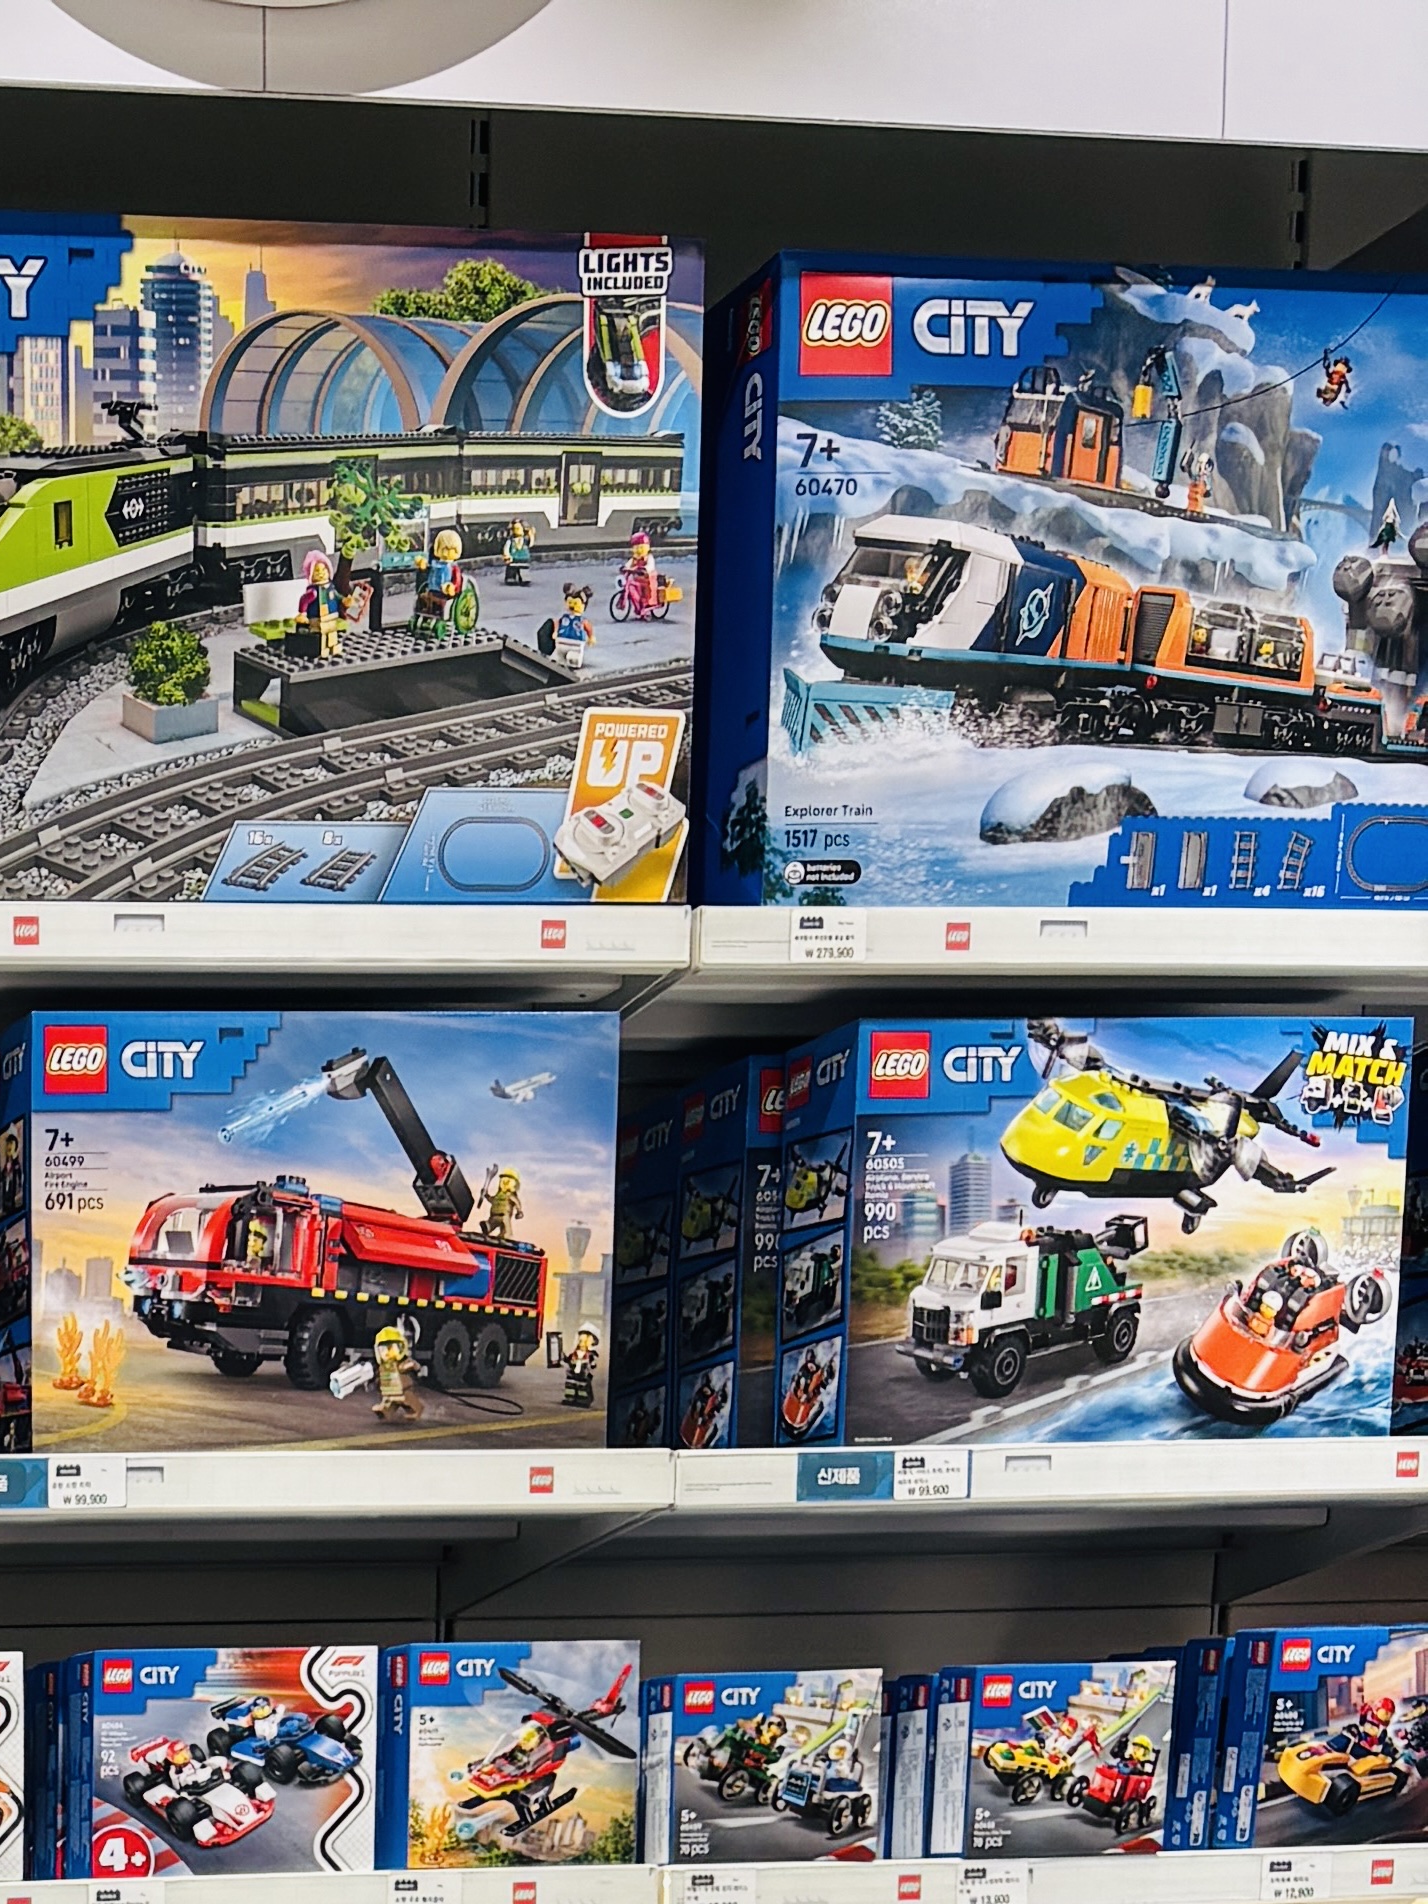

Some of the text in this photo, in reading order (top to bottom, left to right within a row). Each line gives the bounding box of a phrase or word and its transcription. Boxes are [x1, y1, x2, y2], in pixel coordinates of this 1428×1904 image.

[584, 252, 668, 273] LIGHTS
[587, 276, 663, 290] INCLUDED
[803, 297, 1035, 357] LEGO CITY
[796, 434, 841, 468] 7+
[795, 477, 857, 497] 60470
[595, 722, 668, 739] POWERED
[586, 739, 666, 787] UP
[785, 805, 872, 820] Explorer Train
[785, 829, 850, 851] 1517 pcs
[1323, 1031, 1376, 1057] MIX
[46, 1040, 206, 1079] LEGO CITY
[872, 1045, 1023, 1083] LEGO CITY
[1306, 1051, 1407, 1086] MATCH
[45, 1156, 84, 1168] 60499
[866, 1158, 904, 1170] 60505
[45, 1192, 104, 1213] 691 pcs
[864, 1203, 896, 1222] 990
[103, 1666, 180, 1685] LEGO CITY
[419, 1714, 435, 1726] 5+
[101, 1751, 115, 1763] 92
[98, 1838, 146, 1872] 4+
